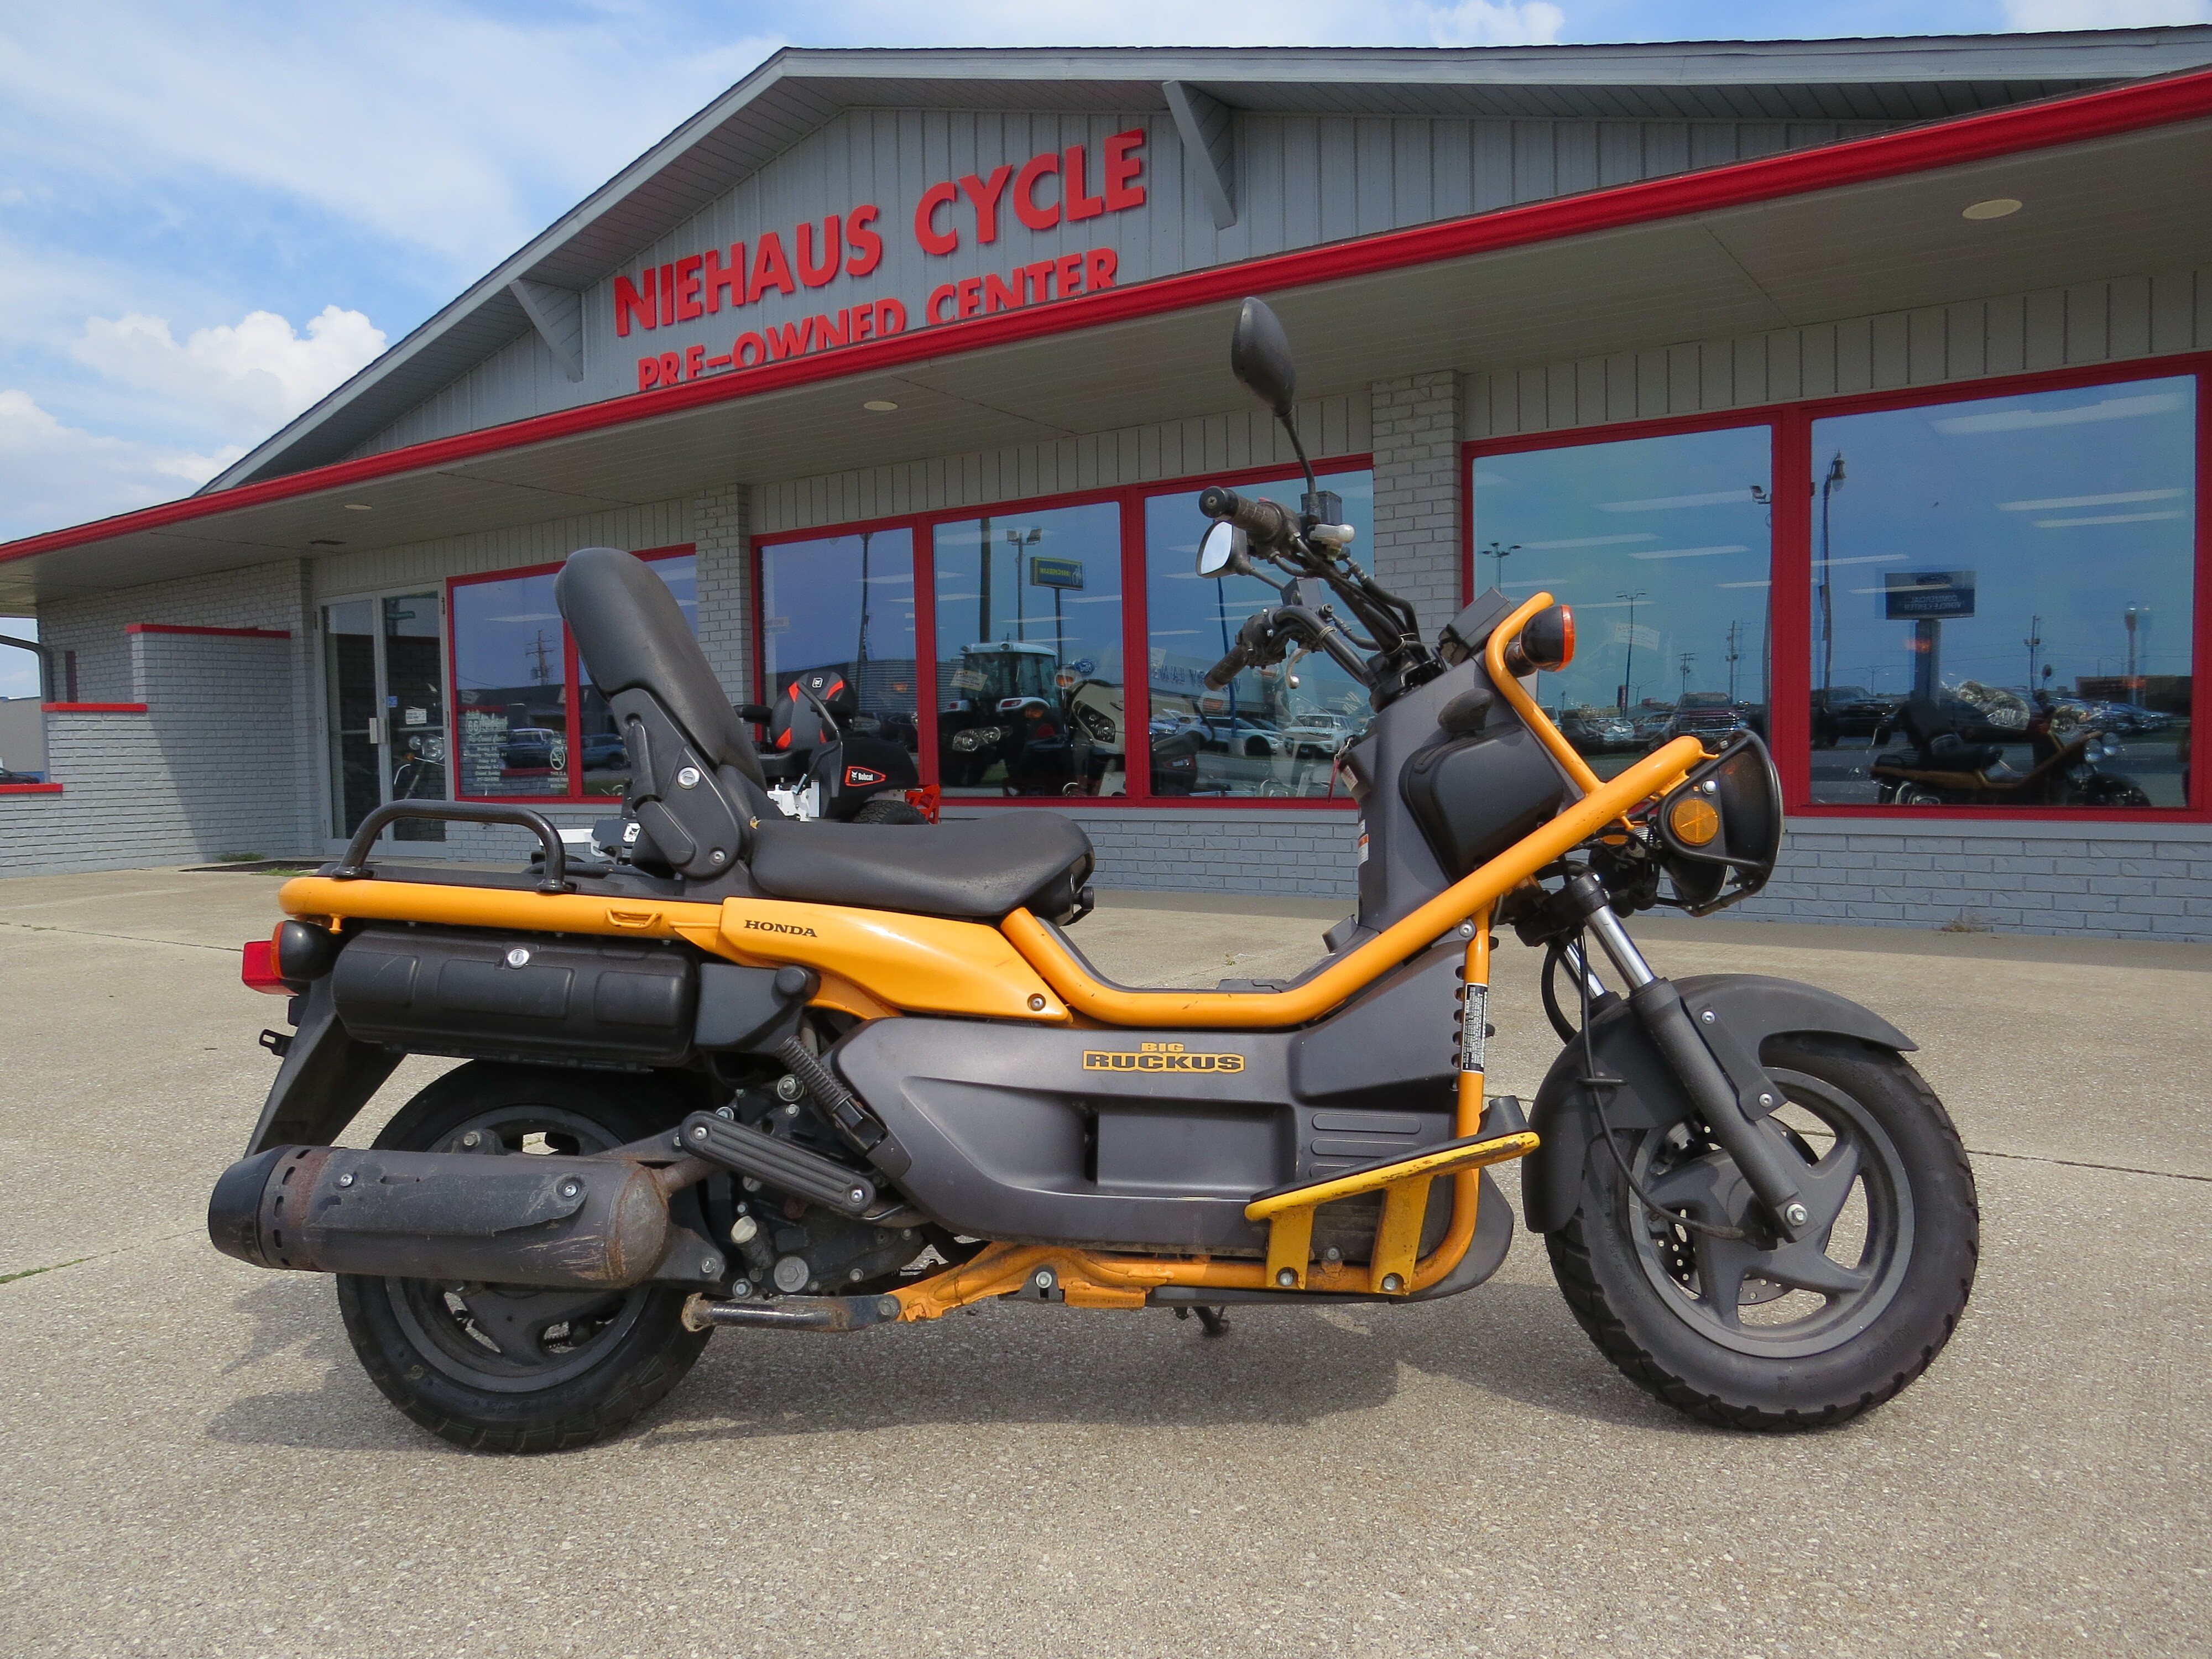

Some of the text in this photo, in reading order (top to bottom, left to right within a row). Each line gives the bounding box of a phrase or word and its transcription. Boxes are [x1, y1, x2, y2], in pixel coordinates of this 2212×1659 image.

[614, 128, 1144, 337] NIEHAUS CYCLE
[638, 248, 1118, 391] PRE-OWNED CENTER
[858, 773, 873, 781] Bobcat
[744, 920, 817, 937] HONDA
[1141, 1042, 1185, 1052] BIG
[1083, 1051, 1244, 1073] RUCKUS
